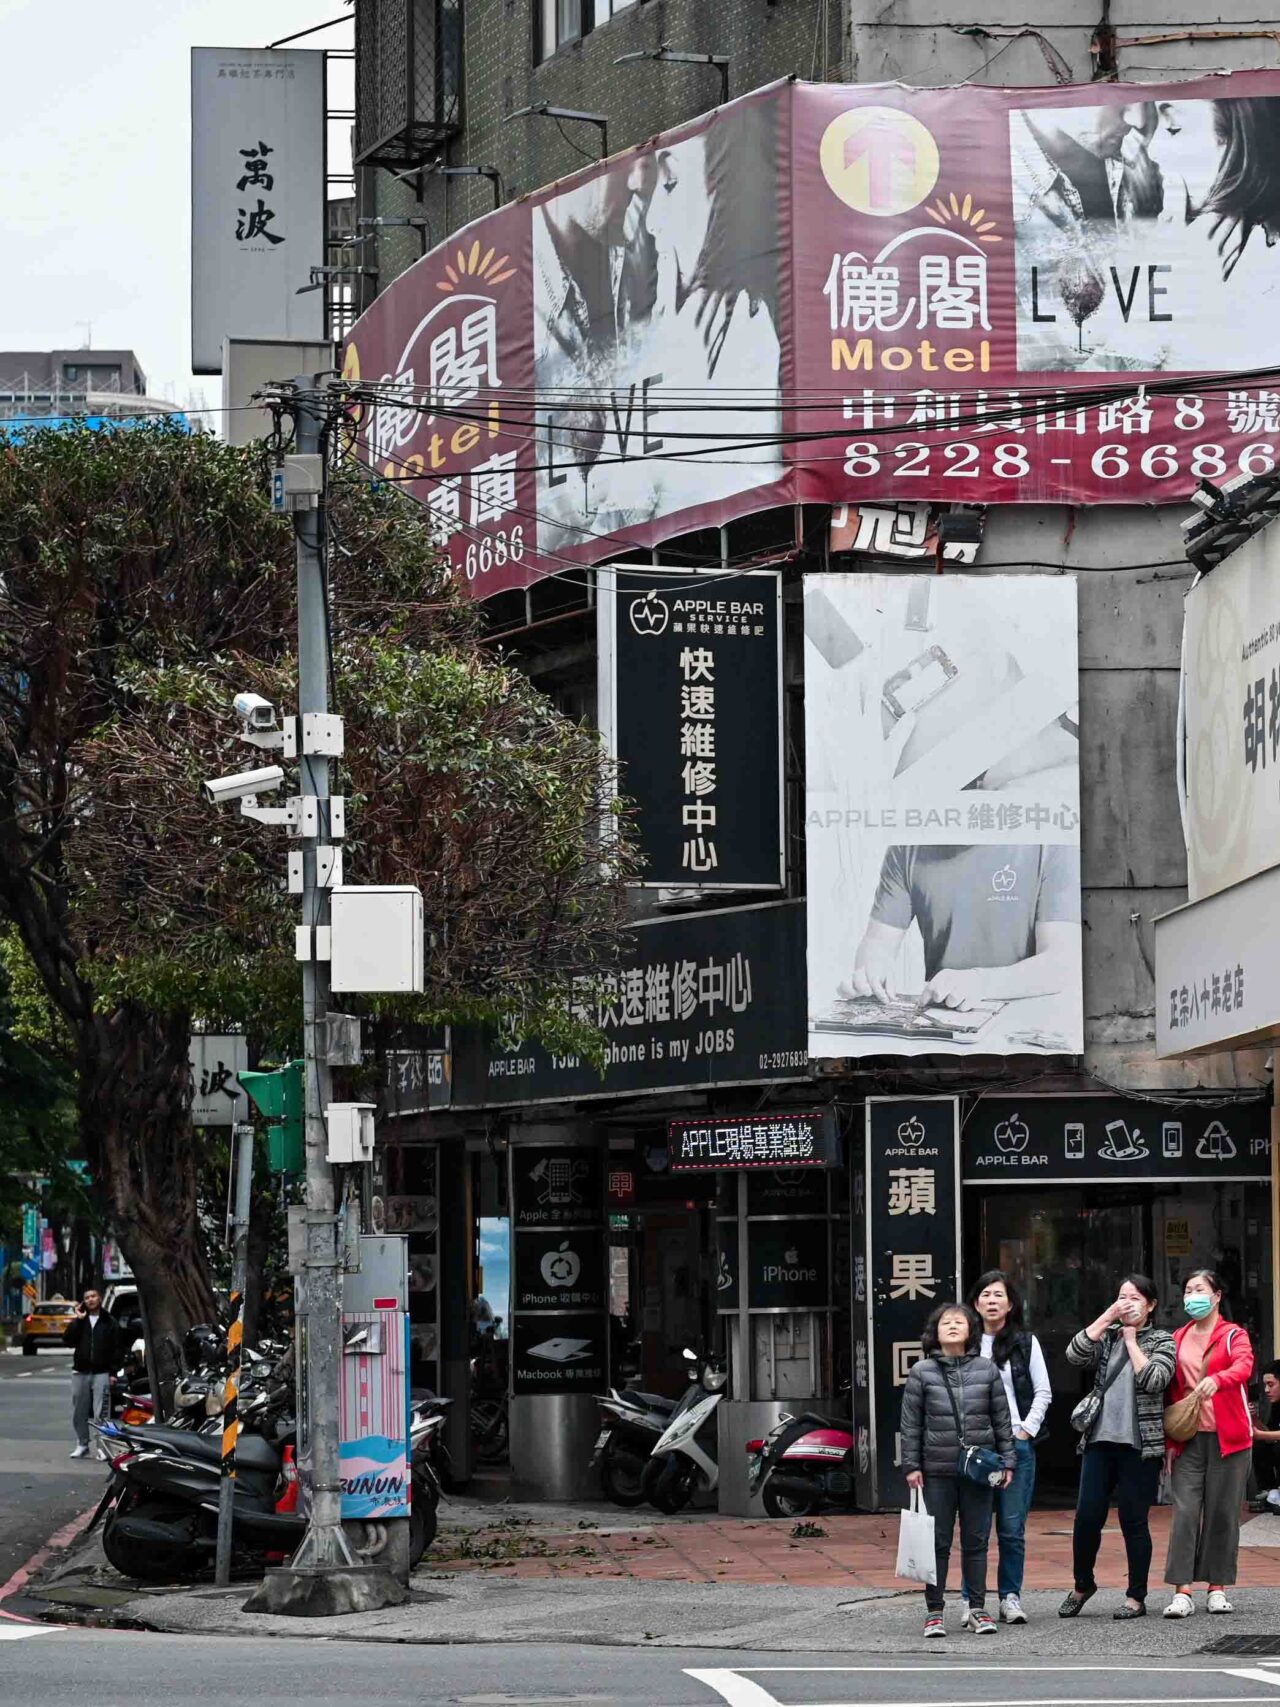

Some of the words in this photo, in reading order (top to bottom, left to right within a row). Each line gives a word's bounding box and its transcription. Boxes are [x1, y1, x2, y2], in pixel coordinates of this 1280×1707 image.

[236, 140, 286, 245] 萬波
[822, 252, 992, 332] 儷閣
[831, 338, 991, 373] Motel
[842, 442, 1275, 481] 8228-6686
[673, 599, 727, 614] APPLE
[730, 601, 764, 616] BAR
[689, 613, 748, 624] SERVICE
[679, 646, 718, 872] 快速維修中心
[806, 810, 897, 829] APPLE
[904, 810, 962, 829] BAR
[967, 803, 1080, 832] 維修中心
[1169, 963, 1245, 1031] 正宗八十年老店
[651, 1037, 664, 1060] is
[669, 1038, 690, 1063] my
[695, 1028, 735, 1055] JOBS
[488, 1060, 516, 1078] APPLE
[516, 1058, 536, 1076] BAR
[885, 1148, 914, 1156] APPLE
[916, 1148, 939, 1156] BAR
[975, 1155, 1020, 1166] APPLE
[1023, 1155, 1049, 1165] BAR
[519, 1210, 549, 1223] Apple
[763, 1265, 817, 1282] iPhone
[522, 1292, 558, 1305] iPhone
[518, 1368, 562, 1380] Macbook
